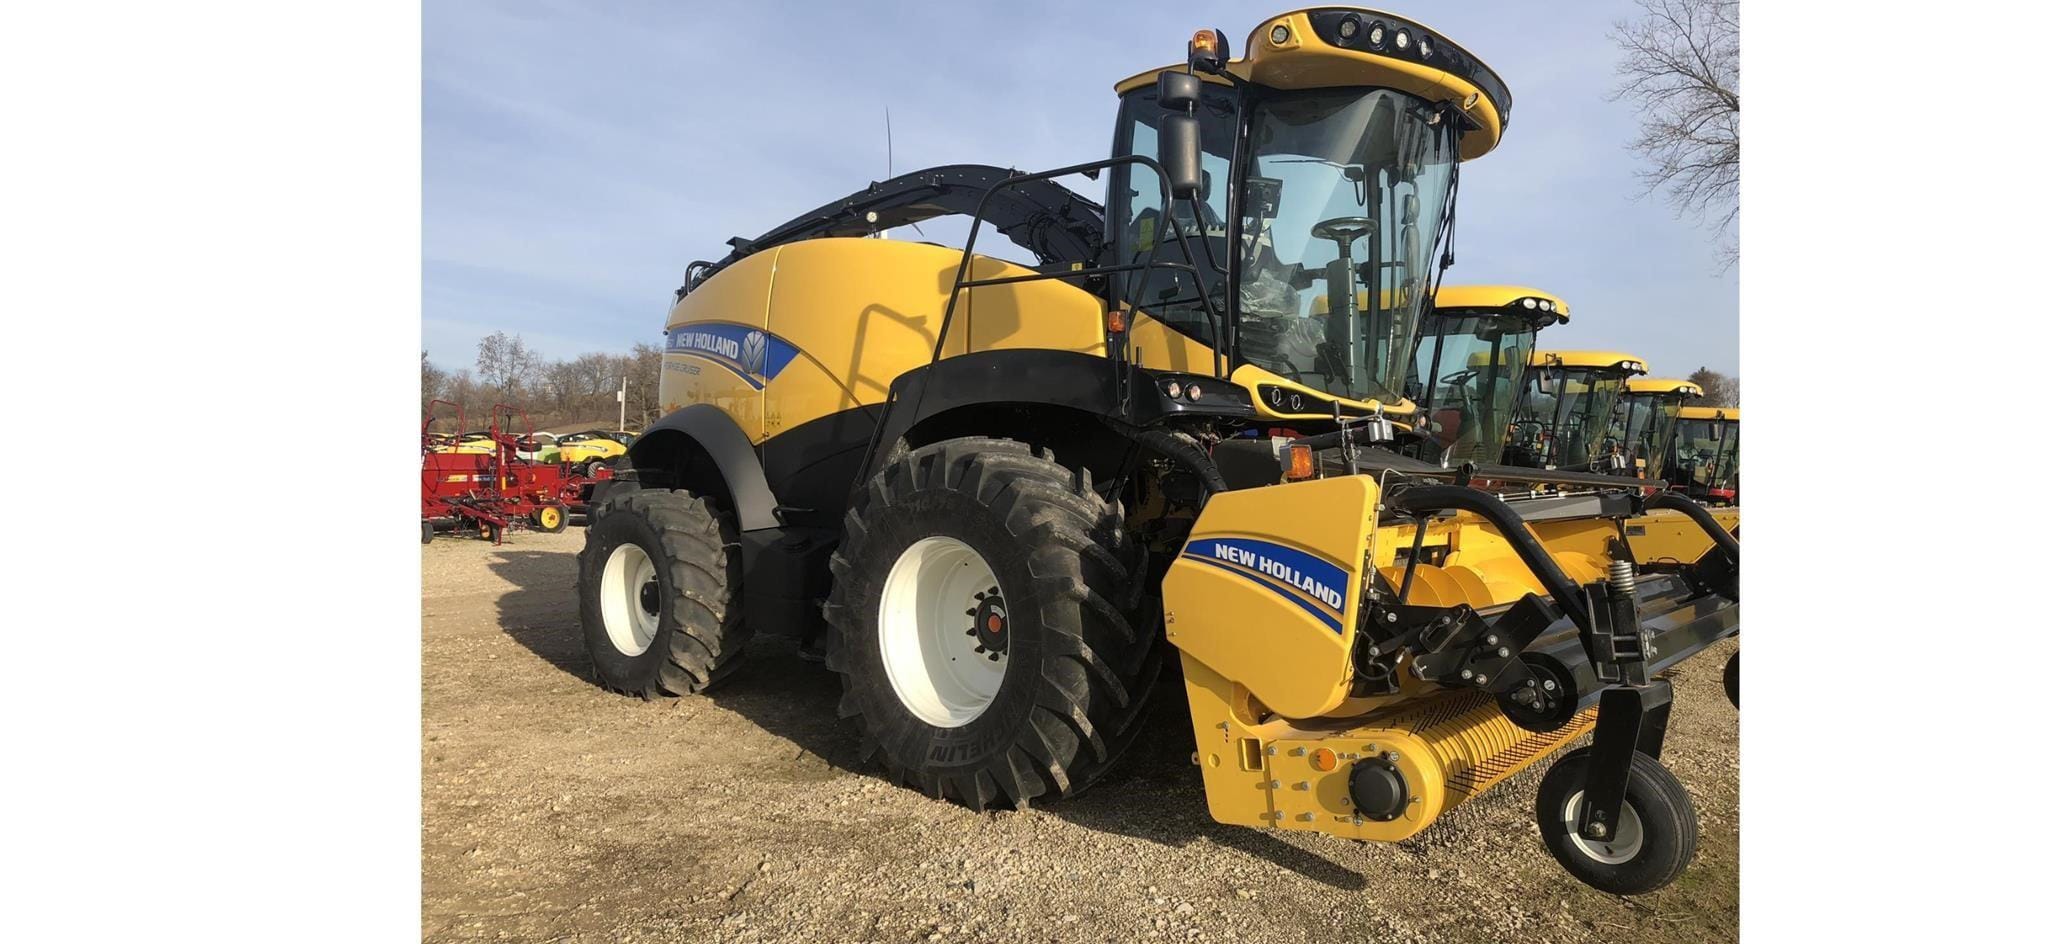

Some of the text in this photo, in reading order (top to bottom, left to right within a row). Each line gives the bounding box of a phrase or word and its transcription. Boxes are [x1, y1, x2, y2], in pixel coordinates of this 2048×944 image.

[676, 332, 695, 348] NEW
[694, 332, 739, 359] HOLLAND
[1215, 543, 1342, 610] NEW HOLLAND
